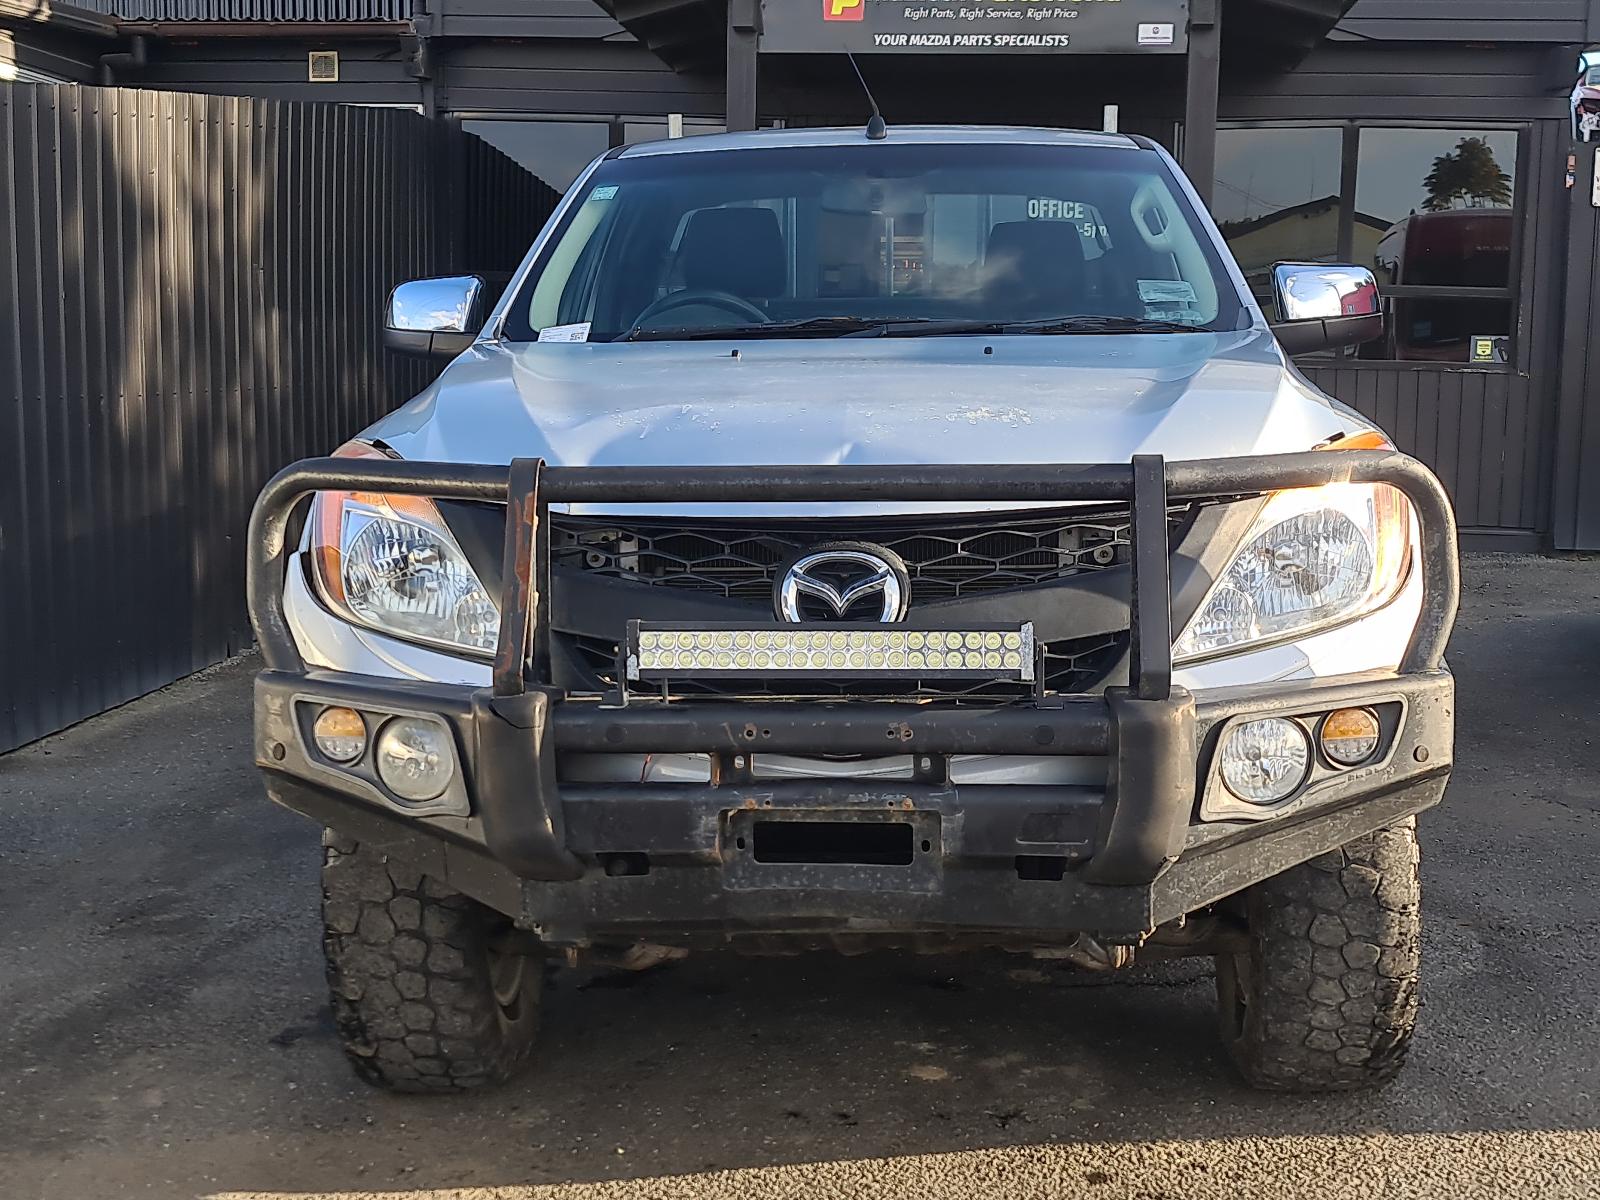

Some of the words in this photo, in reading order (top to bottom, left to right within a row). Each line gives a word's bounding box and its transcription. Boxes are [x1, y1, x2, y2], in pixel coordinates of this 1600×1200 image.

[904, 7, 929, 20] Right
[930, 7, 957, 20] Parts,
[959, 7, 985, 21] Right
[986, 8, 1024, 20] Service,
[1026, 8, 1052, 21] Right
[1053, 8, 1079, 19] Price
[874, 34, 908, 46] YOUR
[909, 34, 951, 46] MAZDA
[953, 34, 992, 46] PARTS
[993, 34, 1070, 47] SPECIALISTS
[1028, 199, 1085, 219] OFFICE
